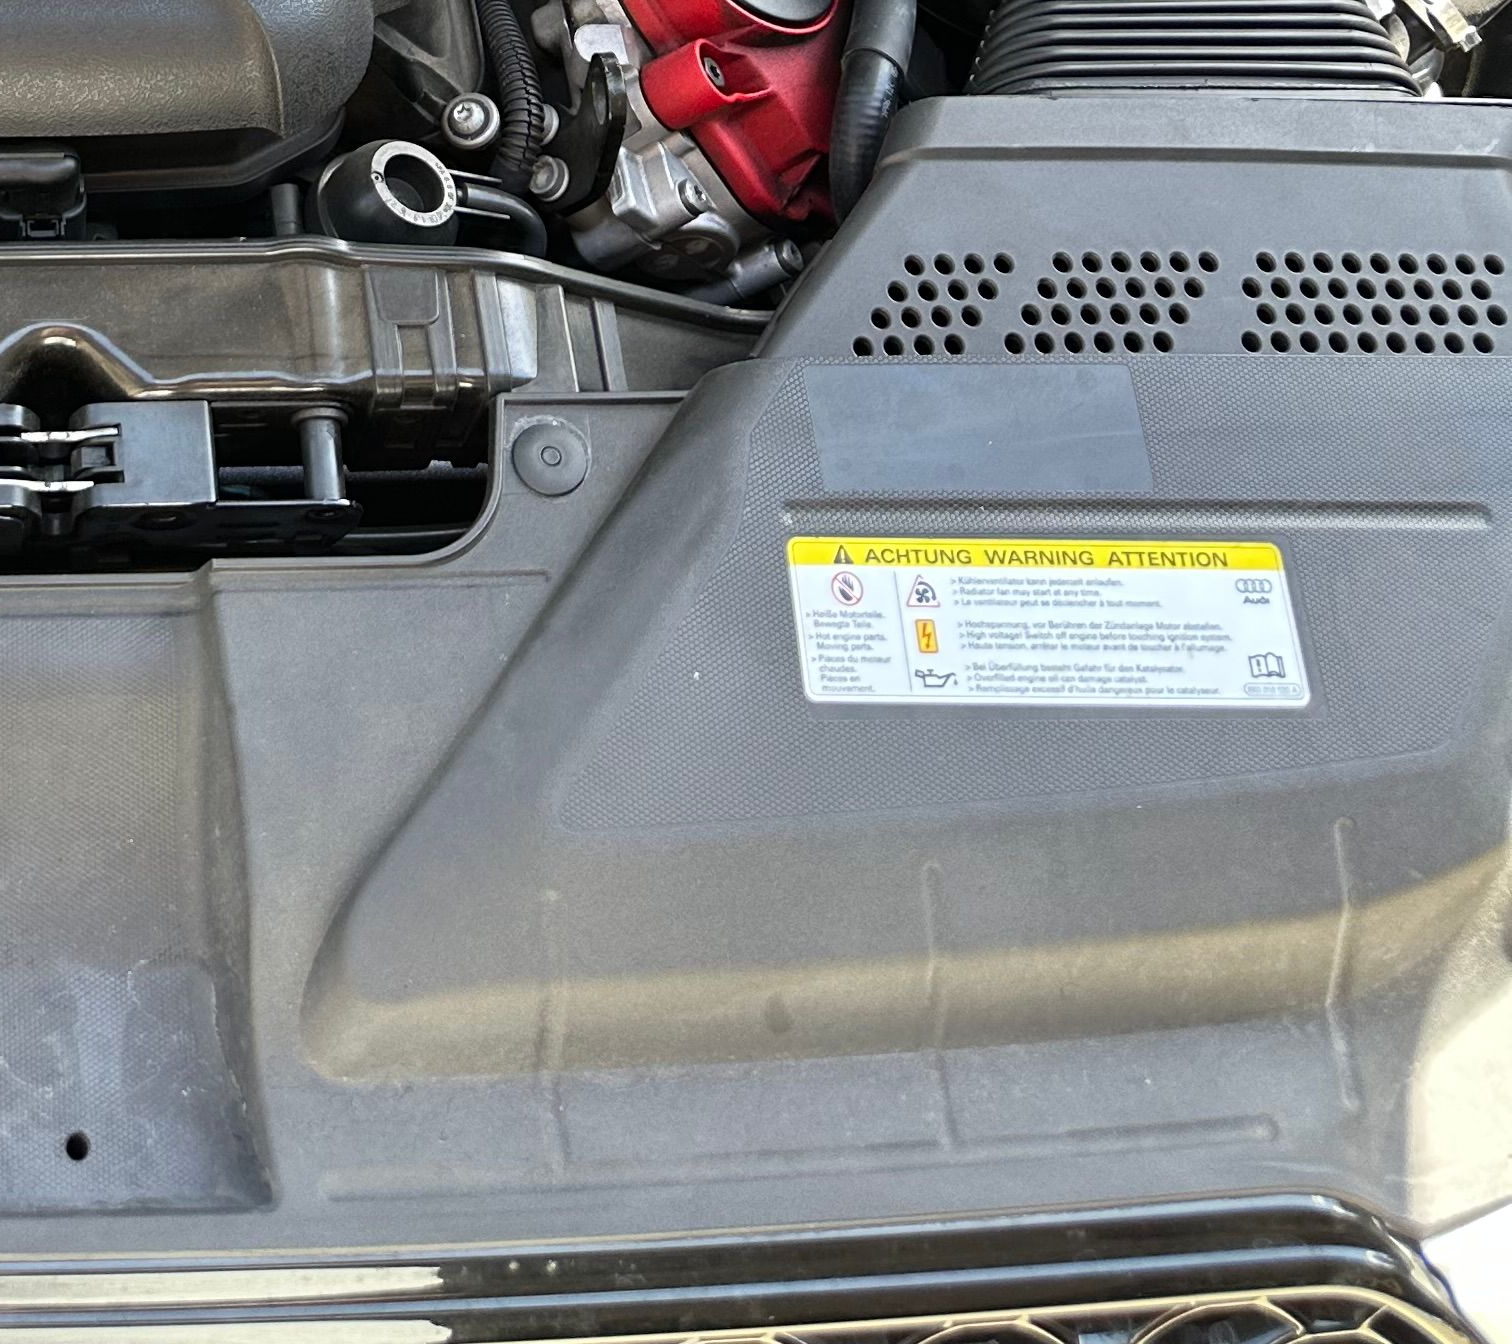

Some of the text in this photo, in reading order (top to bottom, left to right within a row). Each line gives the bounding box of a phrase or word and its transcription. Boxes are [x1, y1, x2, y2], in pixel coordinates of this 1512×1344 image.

[866, 548, 1228, 568] ACHTUNG WARNING ATTENTION
